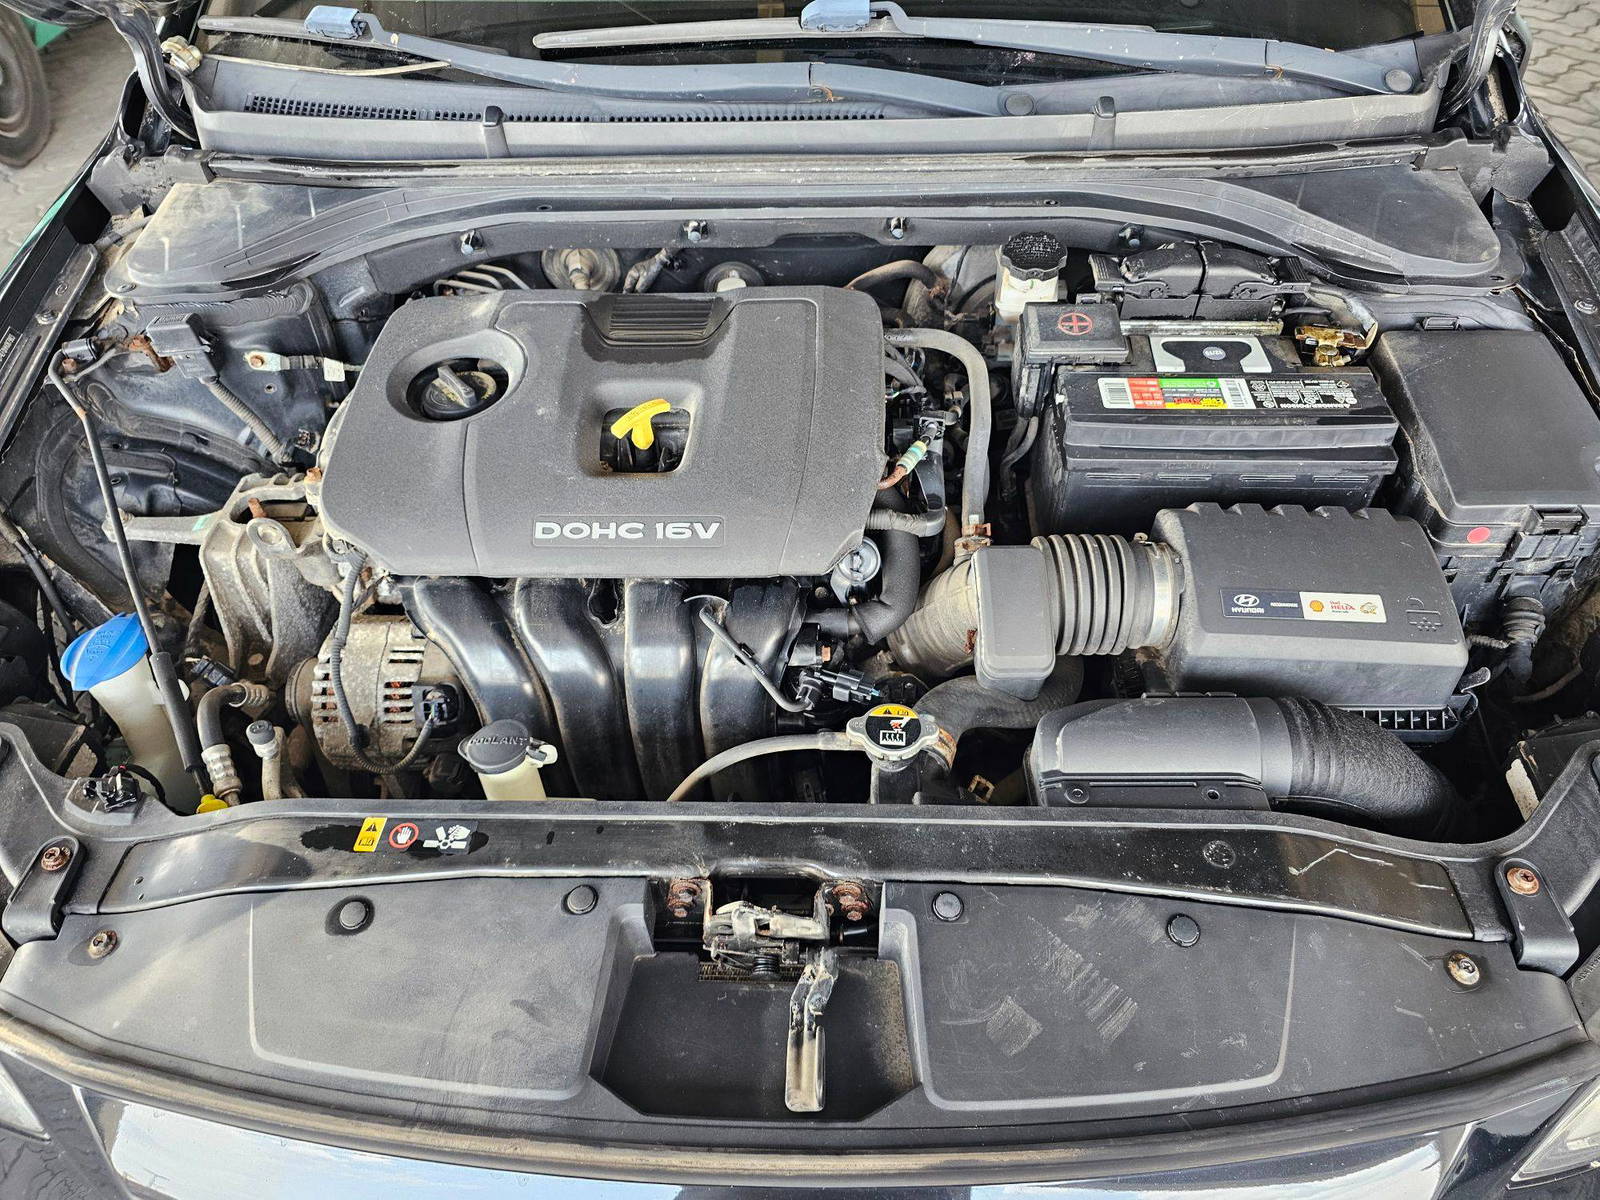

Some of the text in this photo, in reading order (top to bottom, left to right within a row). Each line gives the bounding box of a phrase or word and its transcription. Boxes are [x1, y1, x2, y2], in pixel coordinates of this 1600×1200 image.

[534, 522, 721, 539] DOHC 16V
[1231, 606, 1265, 614] HYUNDAI
[470, 735, 528, 746] COOLANT
